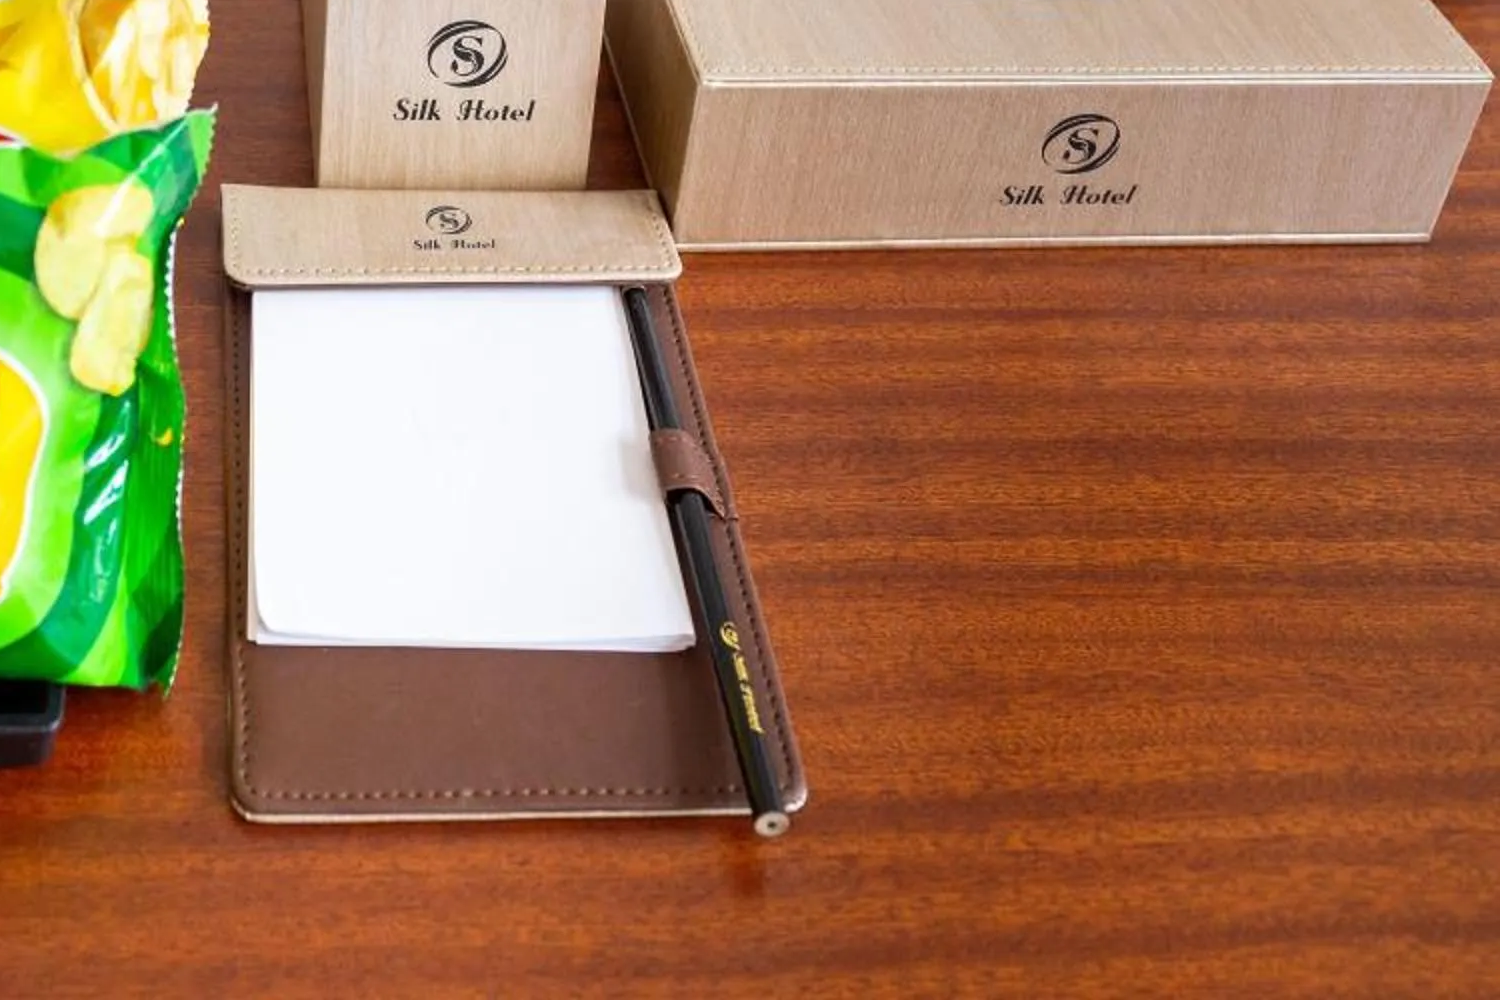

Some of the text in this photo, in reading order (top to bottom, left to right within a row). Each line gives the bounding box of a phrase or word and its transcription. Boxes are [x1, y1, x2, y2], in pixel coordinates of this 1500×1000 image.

[393, 98, 537, 121] Silk Hotel
[1000, 183, 1139, 205] Silk Hotel
[413, 238, 495, 250] Silk Hotel
